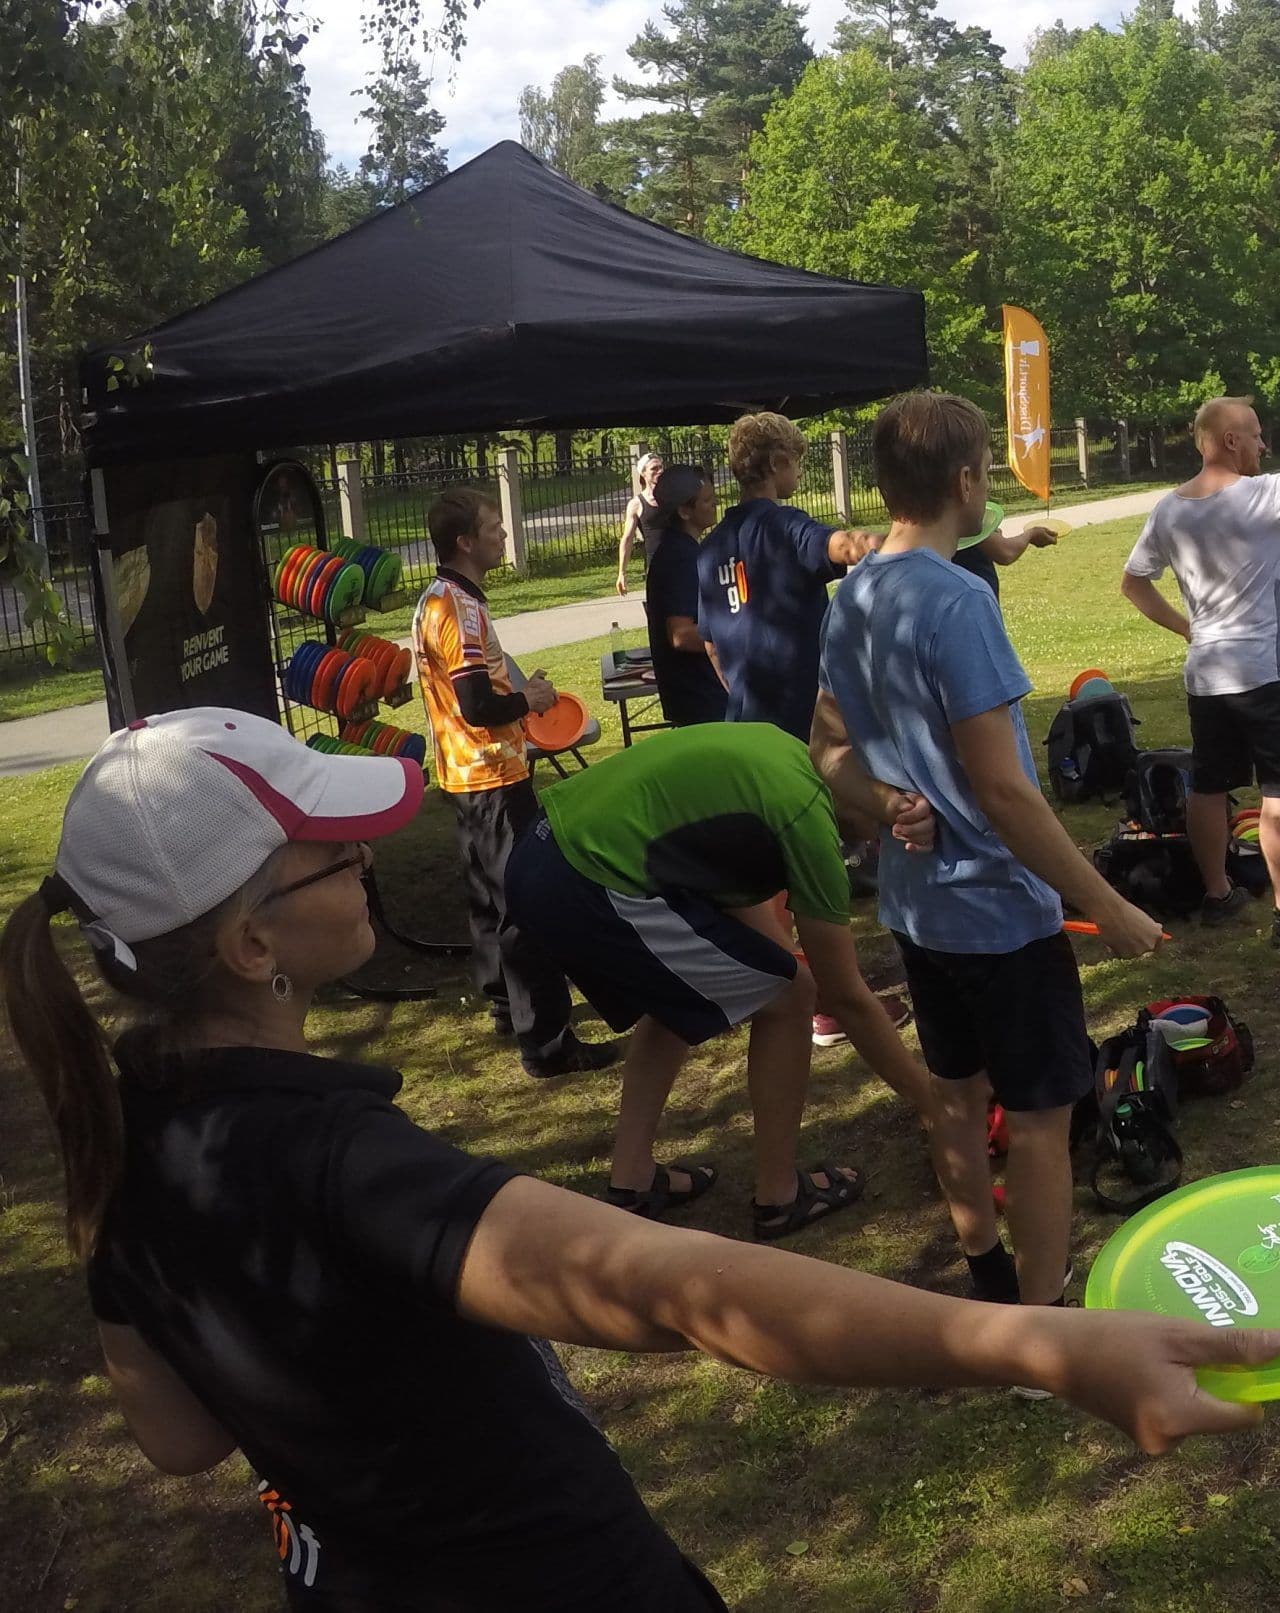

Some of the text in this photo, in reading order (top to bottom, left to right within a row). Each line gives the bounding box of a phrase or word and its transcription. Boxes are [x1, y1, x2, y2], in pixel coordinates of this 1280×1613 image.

[183, 625, 225, 659] REINVENT
[180, 645, 229, 682] YOUR GAME
[1185, 1256, 1214, 1283] GOLF
[1160, 1251, 1236, 1327] INNOVA
[1209, 1283, 1237, 1310] DISC
